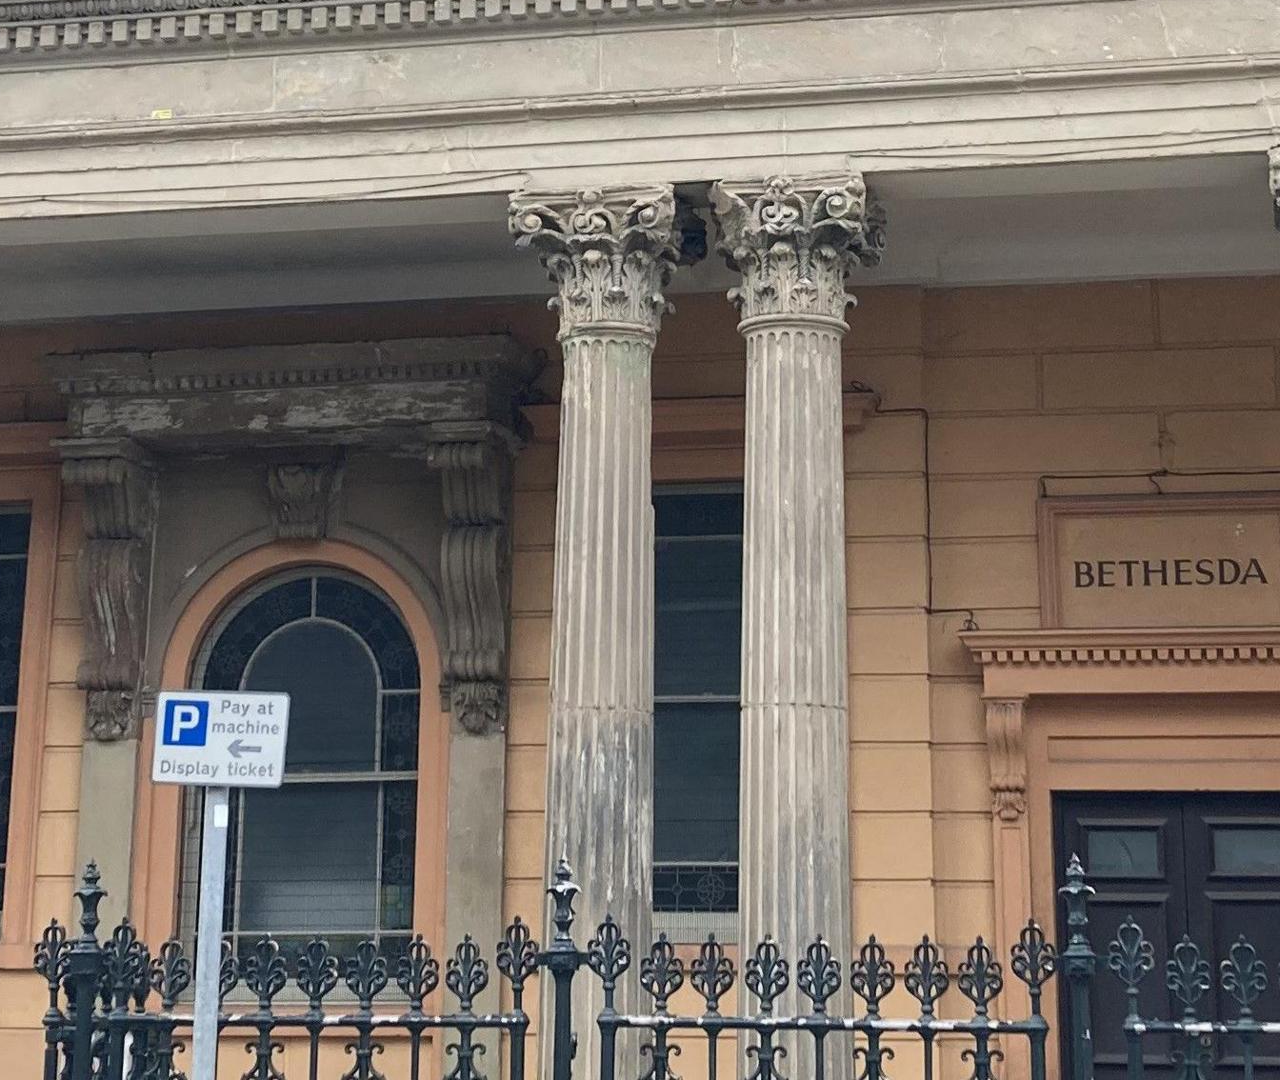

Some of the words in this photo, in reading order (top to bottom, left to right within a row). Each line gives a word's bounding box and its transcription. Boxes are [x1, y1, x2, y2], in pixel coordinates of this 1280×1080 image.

[1073, 557, 1269, 589] BETHESDA
[220, 699, 250, 717] Pay
[257, 700, 275, 716] at
[170, 704, 200, 743] P
[211, 719, 280, 735] machine
[159, 759, 220, 778] Display
[227, 761, 275, 778] ticket
